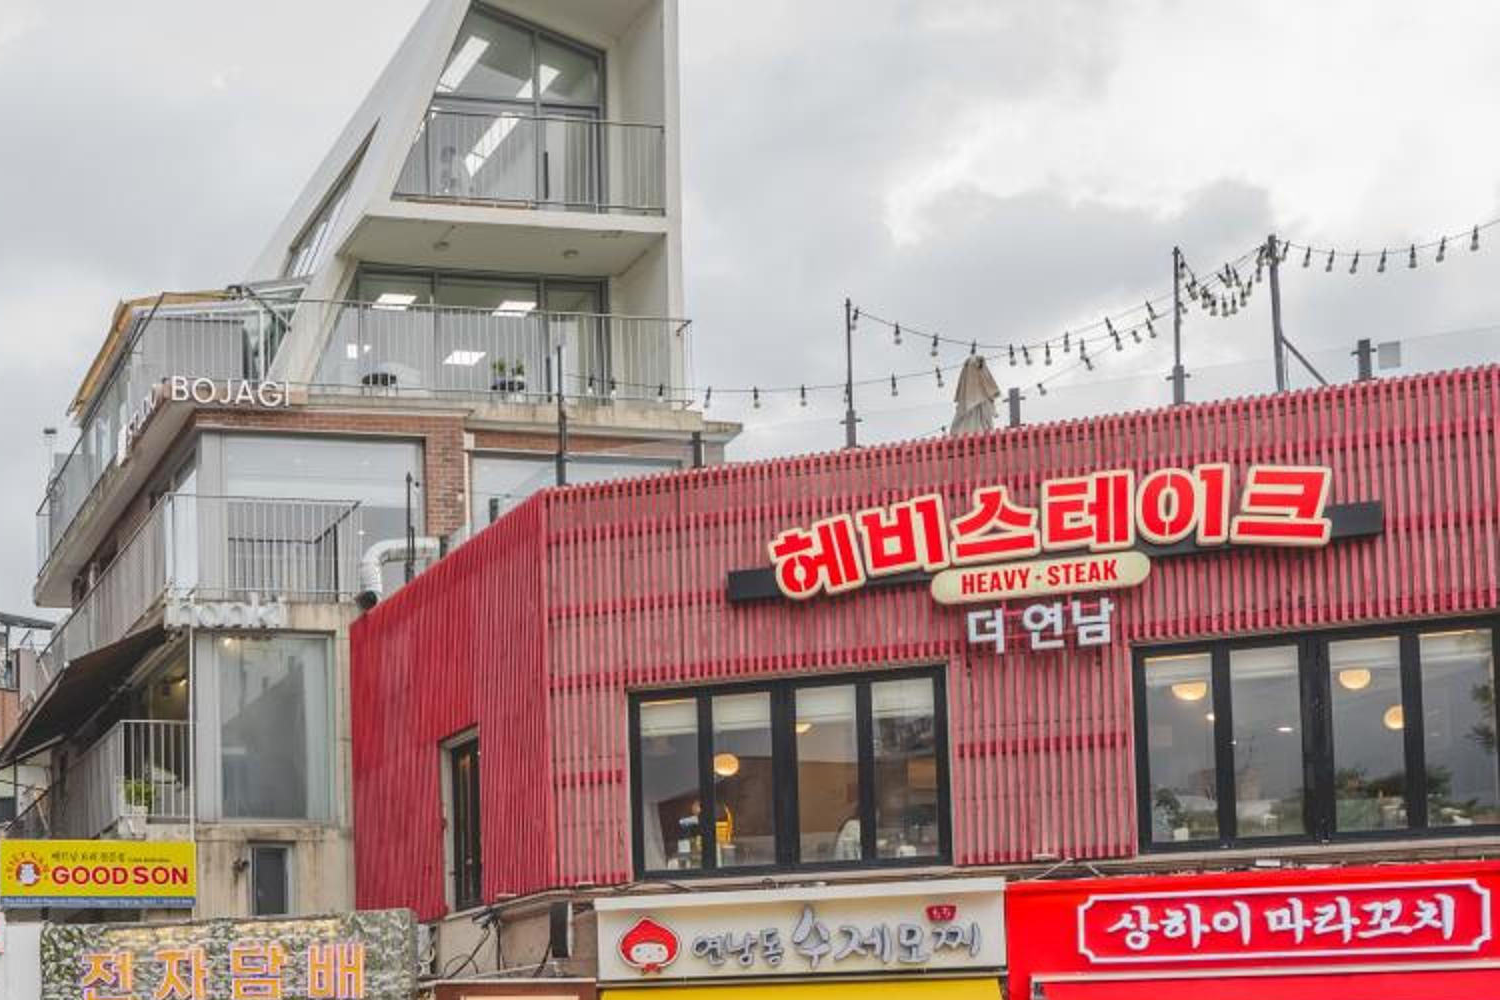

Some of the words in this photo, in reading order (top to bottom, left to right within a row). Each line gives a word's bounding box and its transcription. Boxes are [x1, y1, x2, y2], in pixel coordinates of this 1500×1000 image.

[171, 375, 290, 406] BOJAGI
[770, 464, 1332, 598] 헤비스테이크
[961, 570, 1030, 596] HEAVY
[1048, 561, 1118, 586] STEAK
[1107, 902, 1251, 950] 상하이
[1263, 893, 1455, 944] 마라꼬치
